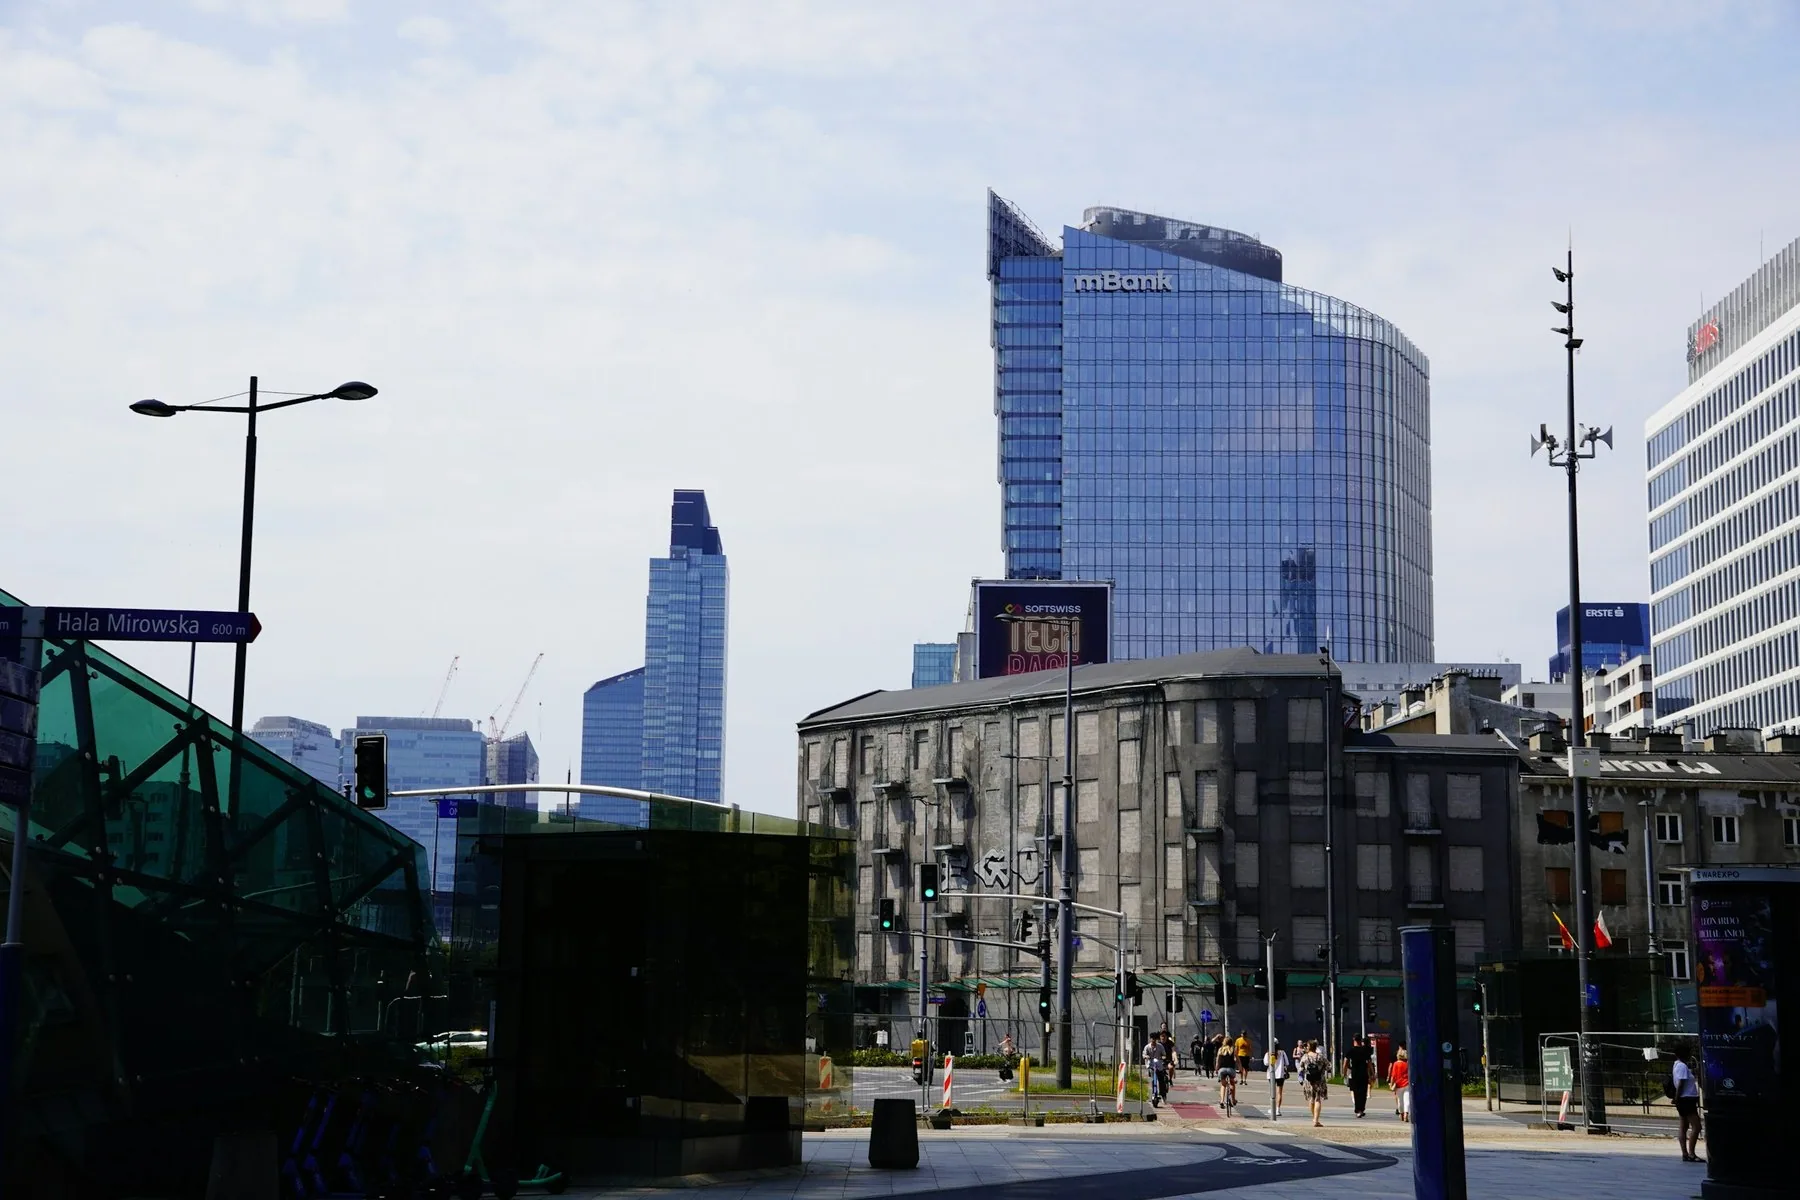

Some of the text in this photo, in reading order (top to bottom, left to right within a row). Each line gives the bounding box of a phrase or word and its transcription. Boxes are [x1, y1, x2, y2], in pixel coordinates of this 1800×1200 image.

[1074, 269, 1173, 292] mBank
[1024, 604, 1082, 613] SOFTSWISS
[1585, 609, 1614, 617] ERSTE
[57, 612, 246, 636] Hala Mirowska 600 m
[1009, 616, 1080, 653] TECH
[1702, 870, 1740, 878] WAREXPO
